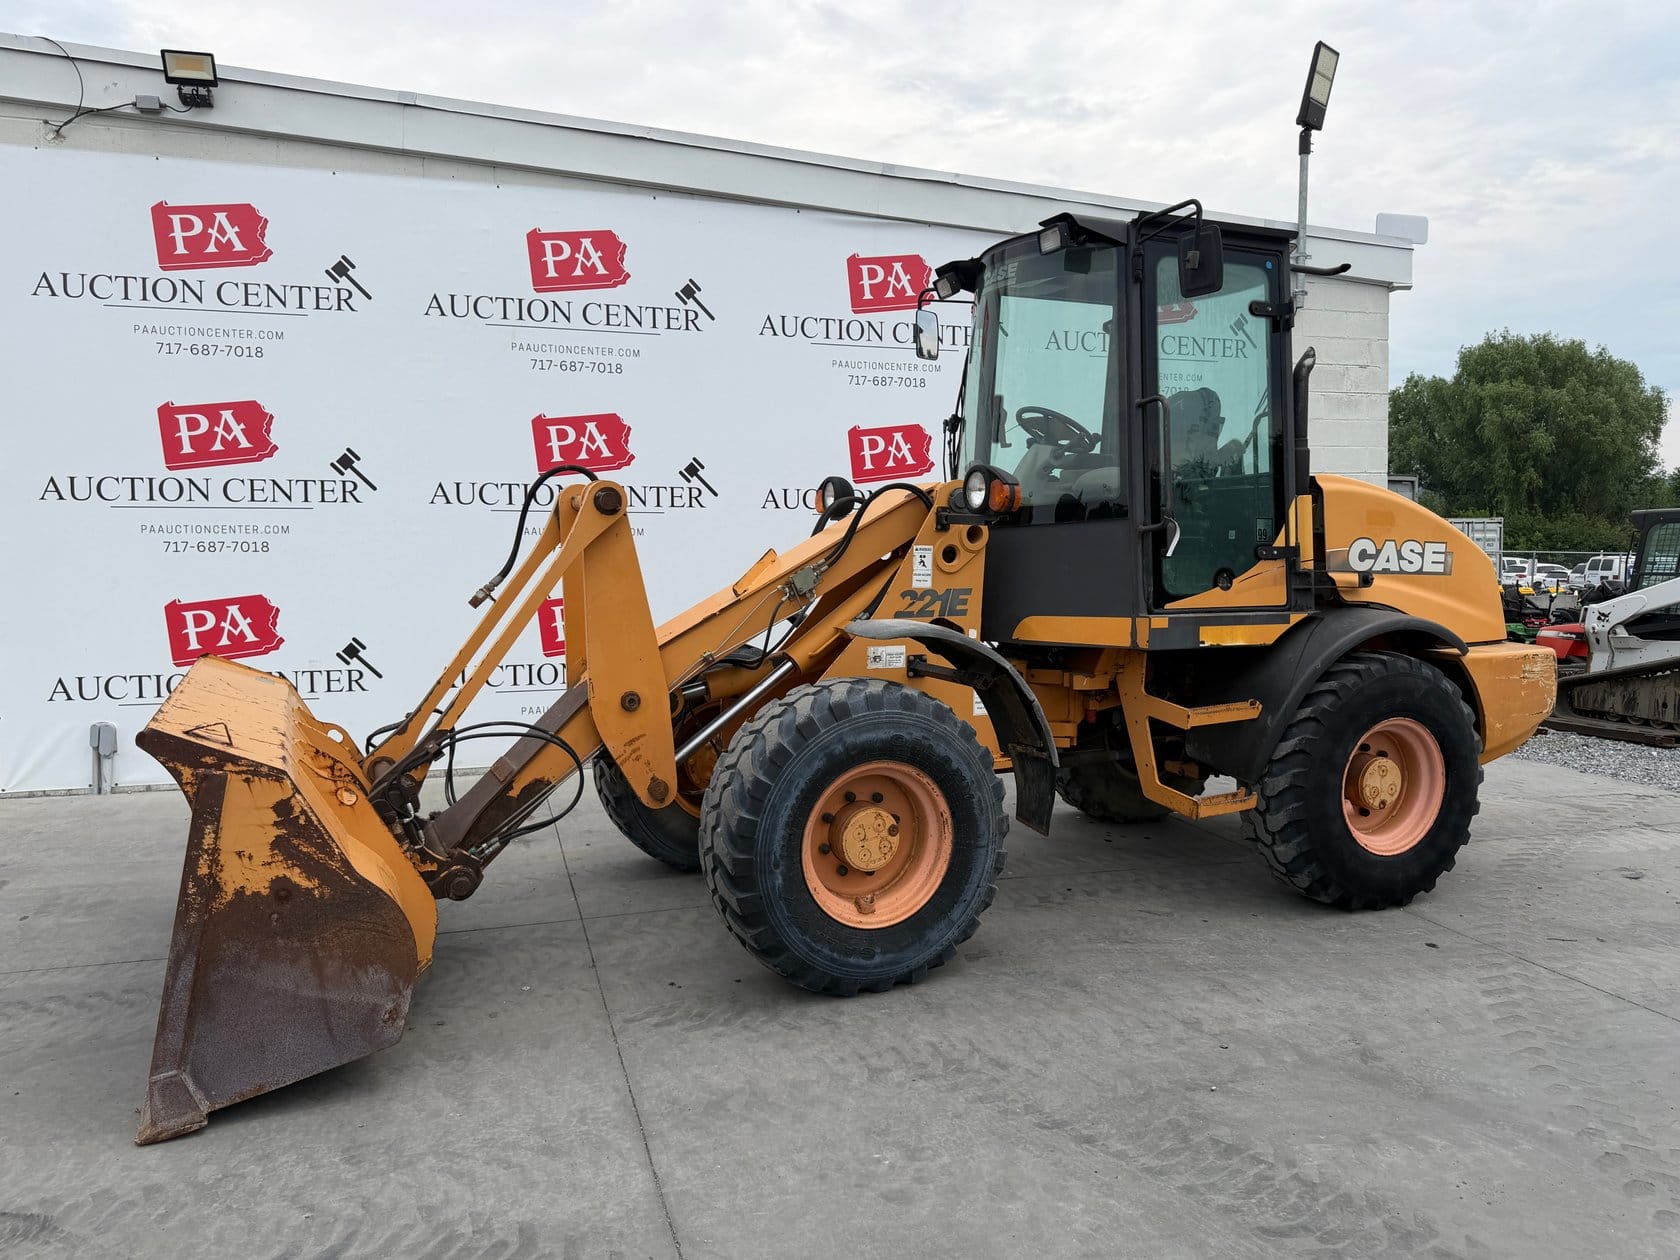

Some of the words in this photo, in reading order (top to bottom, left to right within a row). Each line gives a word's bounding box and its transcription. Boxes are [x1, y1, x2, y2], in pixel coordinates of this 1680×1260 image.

[168, 212, 248, 255] PA
[541, 237, 609, 278] PA
[31, 271, 204, 304] AUCTION
[216, 280, 358, 312] CENTER
[859, 262, 916, 300] PA
[424, 293, 573, 324] AUCTION
[582, 303, 703, 332] CENTER
[133, 324, 285, 340] PAAUCTIONCENTER.COM
[758, 314, 884, 342] AUCTION
[156, 342, 264, 359] 717-687-7018
[511, 342, 641, 358] PAAUCTIONCENTER.COM
[1044, 329, 1108, 352] AUCT
[1161, 335, 1248, 359] CENTER
[530, 359, 623, 375] 717-687-7018
[832, 359, 941, 373] PAAUCTIONCENTER.COM
[848, 375, 926, 388] 717-687-7018
[174, 410, 255, 454] PA
[546, 421, 613, 462] PA
[860, 432, 916, 470] PA
[39, 475, 210, 502] AUCTION
[222, 477, 363, 504] CENTER
[429, 481, 563, 507] AUCTIO
[621, 485, 707, 509] NTER
[140, 524, 290, 535] PAAUCTIONCENTER.COM
[163, 541, 270, 553] 717-687-7018
[1348, 538, 1447, 574] CASE
[894, 588, 973, 619] 221E
[181, 604, 261, 651] PA
